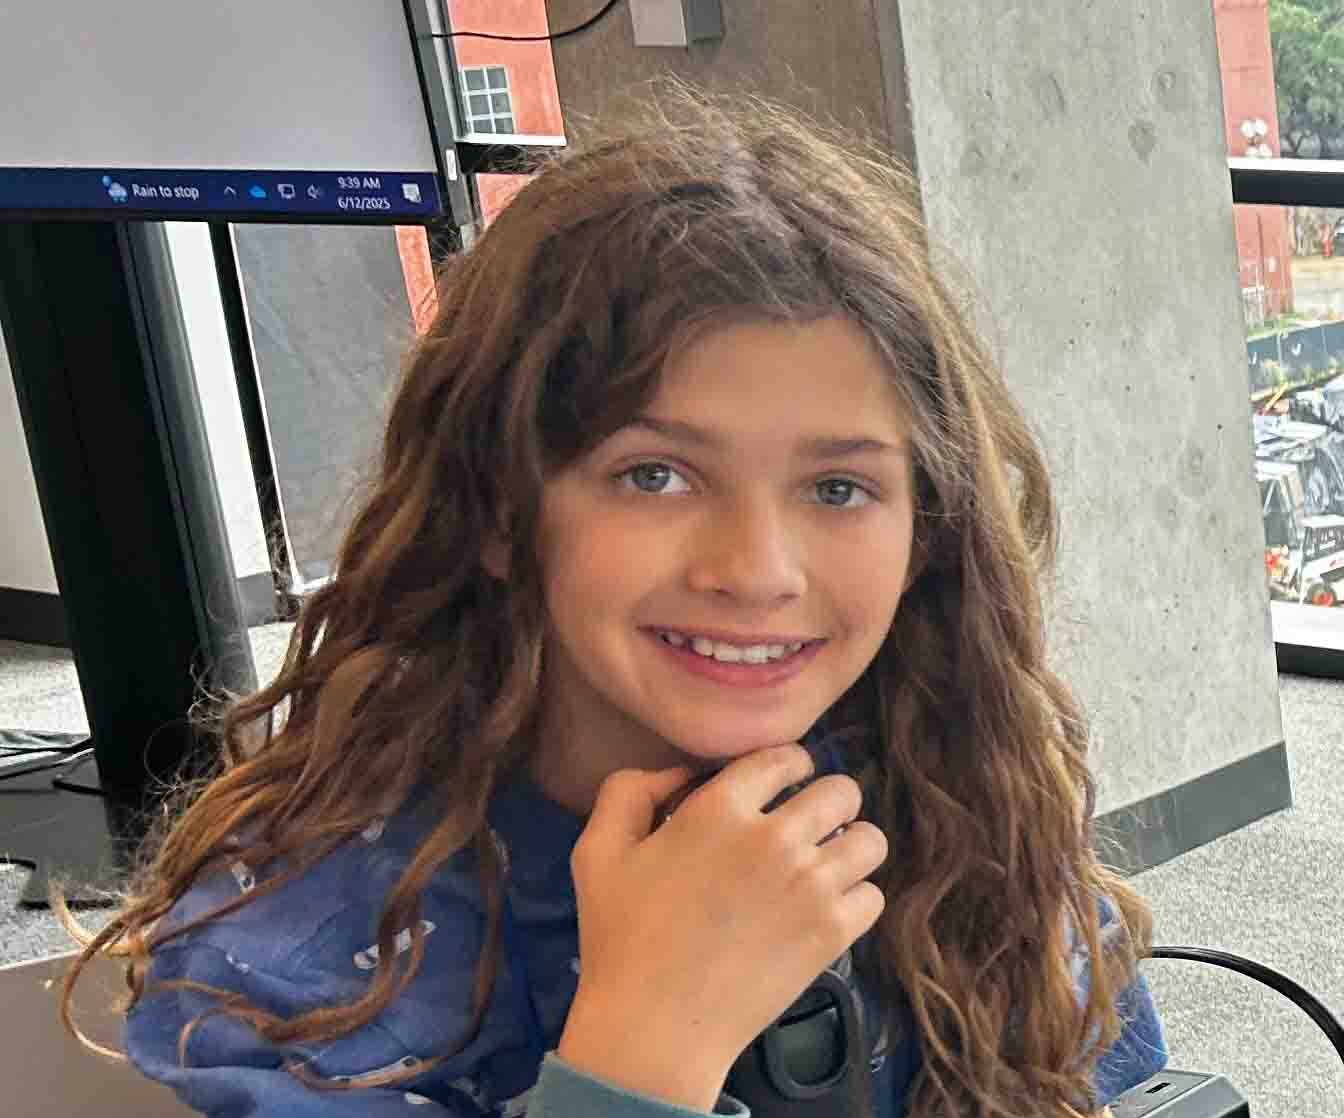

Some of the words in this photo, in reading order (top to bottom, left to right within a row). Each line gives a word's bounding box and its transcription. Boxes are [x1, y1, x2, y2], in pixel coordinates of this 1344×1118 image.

[362, 177, 381, 189] AM
[132, 183, 158, 198] Rain
[159, 185, 173, 198] to
[173, 185, 200, 201] stop
[337, 196, 392, 210] 6/12/2025
